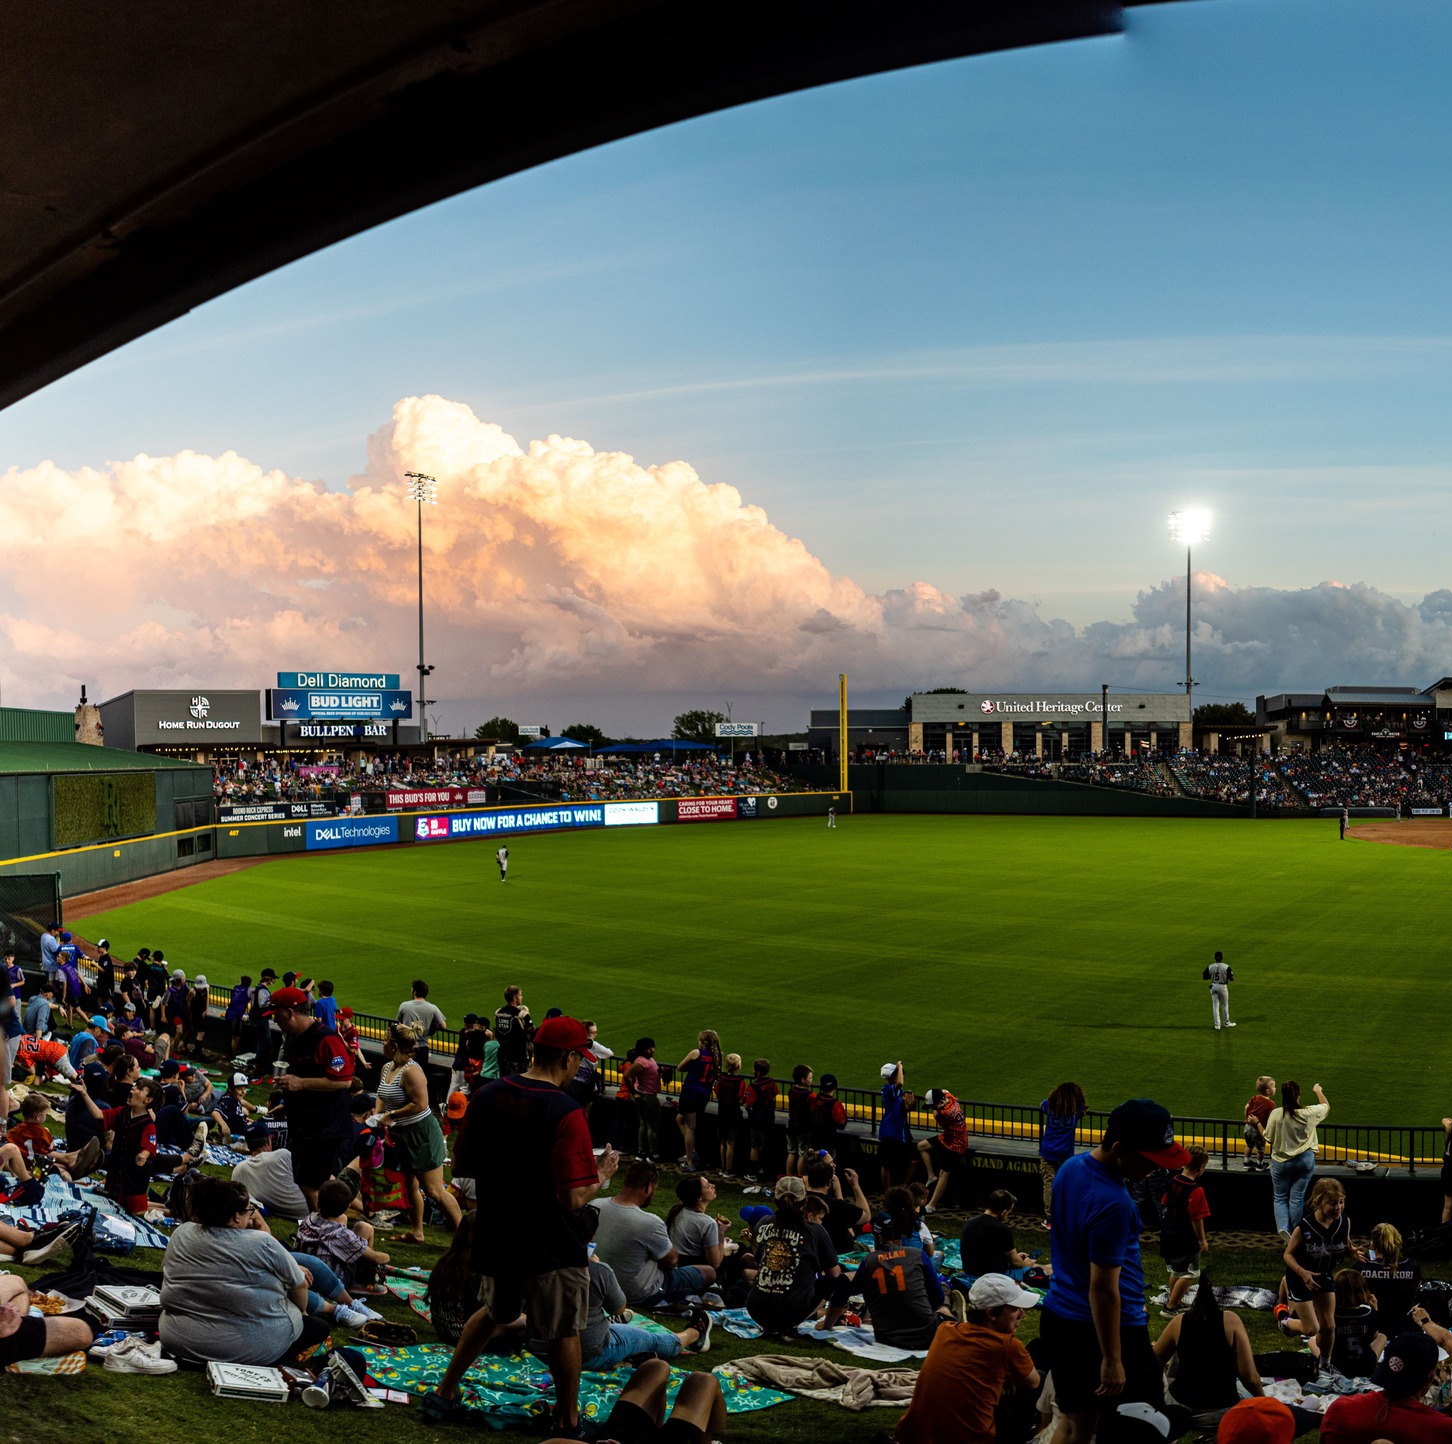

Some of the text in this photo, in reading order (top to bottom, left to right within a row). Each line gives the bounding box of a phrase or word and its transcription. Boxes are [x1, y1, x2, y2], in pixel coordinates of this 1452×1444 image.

[297, 673, 387, 688] Dell Diamond
[311, 696, 379, 708] BUD LIGHT
[995, 701, 1034, 713] United
[1035, 701, 1085, 715] Heritage
[158, 720, 240, 730] HOME RUN DUGOUT
[300, 725, 387, 737] BULLPEN BAR
[719, 724, 735, 732] Cody
[389, 792, 450, 805] THIS BUD'S FOR YOU
[232, 807, 246, 815] ROUND
[246, 806, 256, 814] ROCK
[291, 804, 308, 813] DELL
[678, 806, 700, 815] CLOSE
[700, 806, 710, 814] TO
[711, 805, 734, 813] HOME.
[220, 815, 244, 823] SUMMER
[452, 809, 601, 833] BUY NOW FOR A CHANCE TO WIN!
[283, 826, 302, 838] intel
[315, 825, 390, 841] DELL Technologies
[24, 1138, 35, 1162] 1
[860, 1144, 880, 1155] NOT
[970, 1156, 1005, 1170] STAND
[871, 1264, 907, 1295] 11
[1361, 1269, 1414, 1279] COACH KORI
